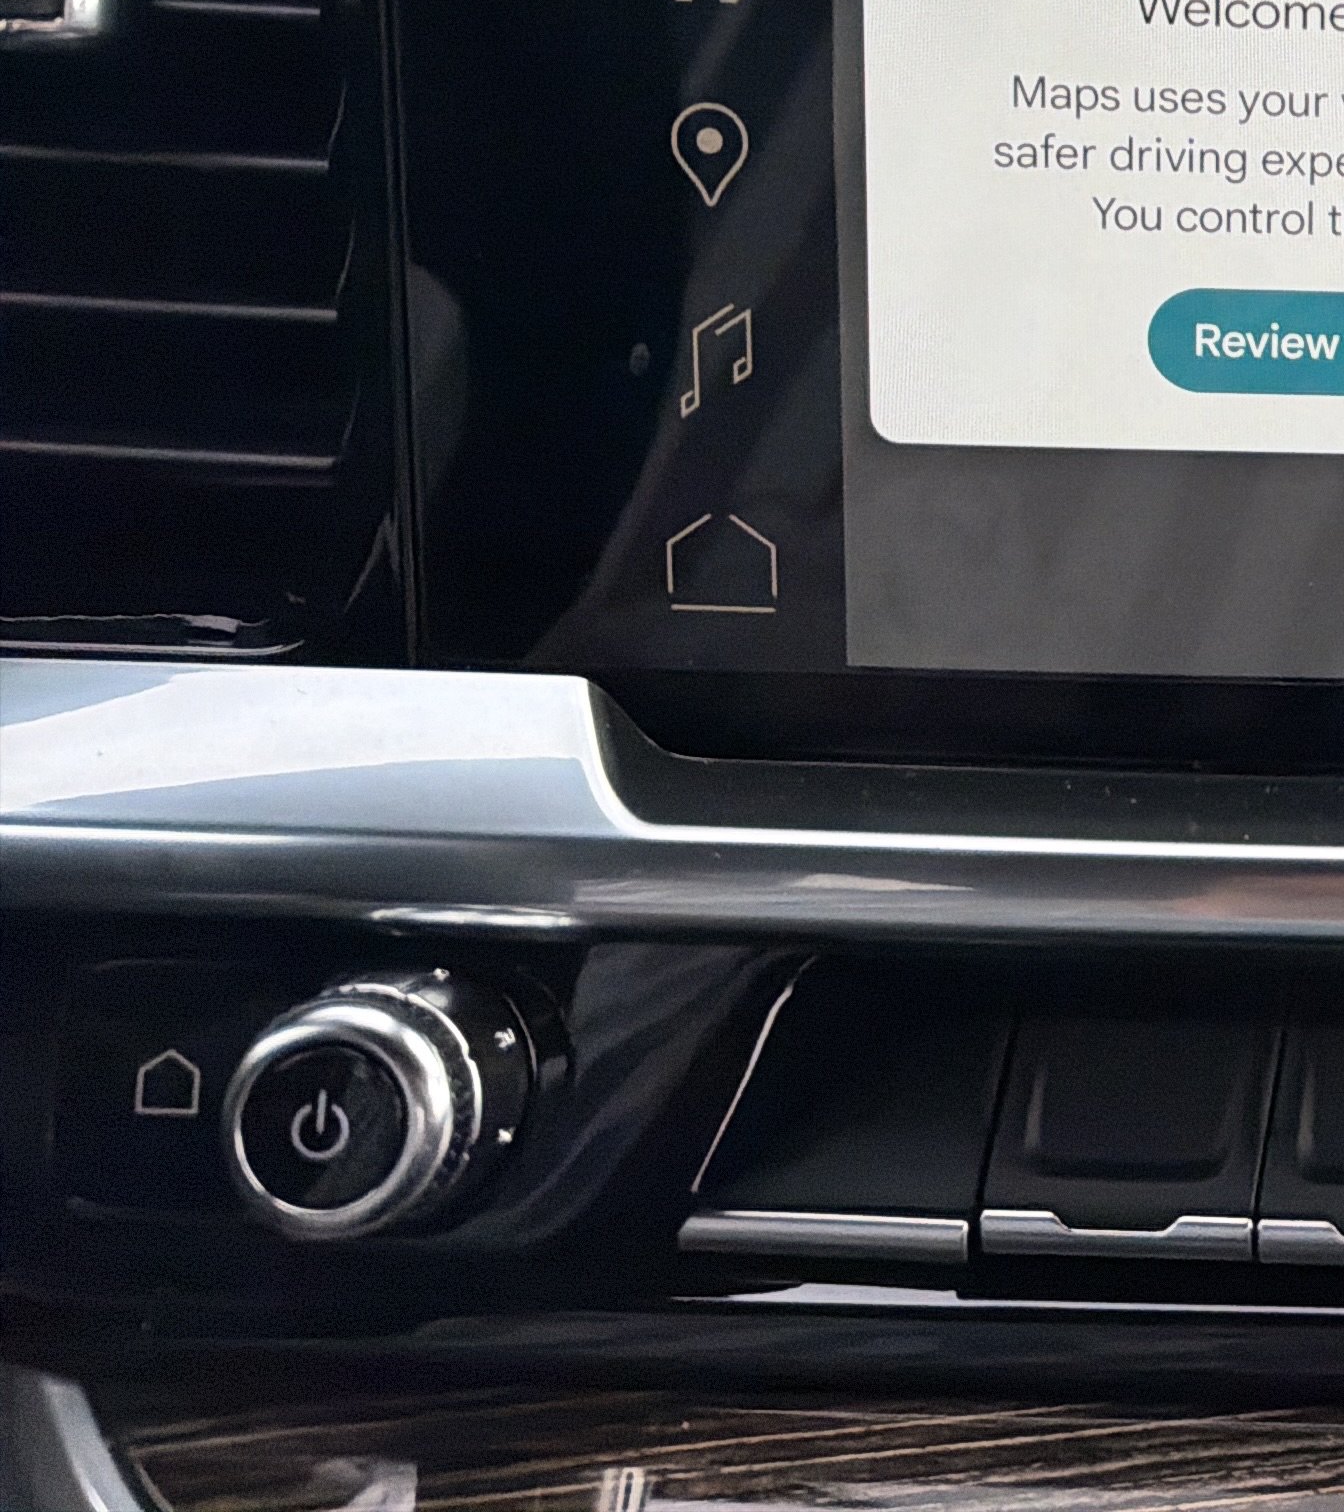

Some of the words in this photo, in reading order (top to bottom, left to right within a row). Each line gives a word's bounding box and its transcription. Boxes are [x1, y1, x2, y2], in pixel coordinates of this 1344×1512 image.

[1013, 75, 1121, 120] Maps
[1134, 86, 1227, 115] uses
[1238, 90, 1329, 125] your
[994, 132, 1097, 170] safer
[1110, 135, 1247, 184] driving
[1092, 196, 1162, 232] You
[1176, 200, 1314, 236] control
[1195, 322, 1340, 360] Review
